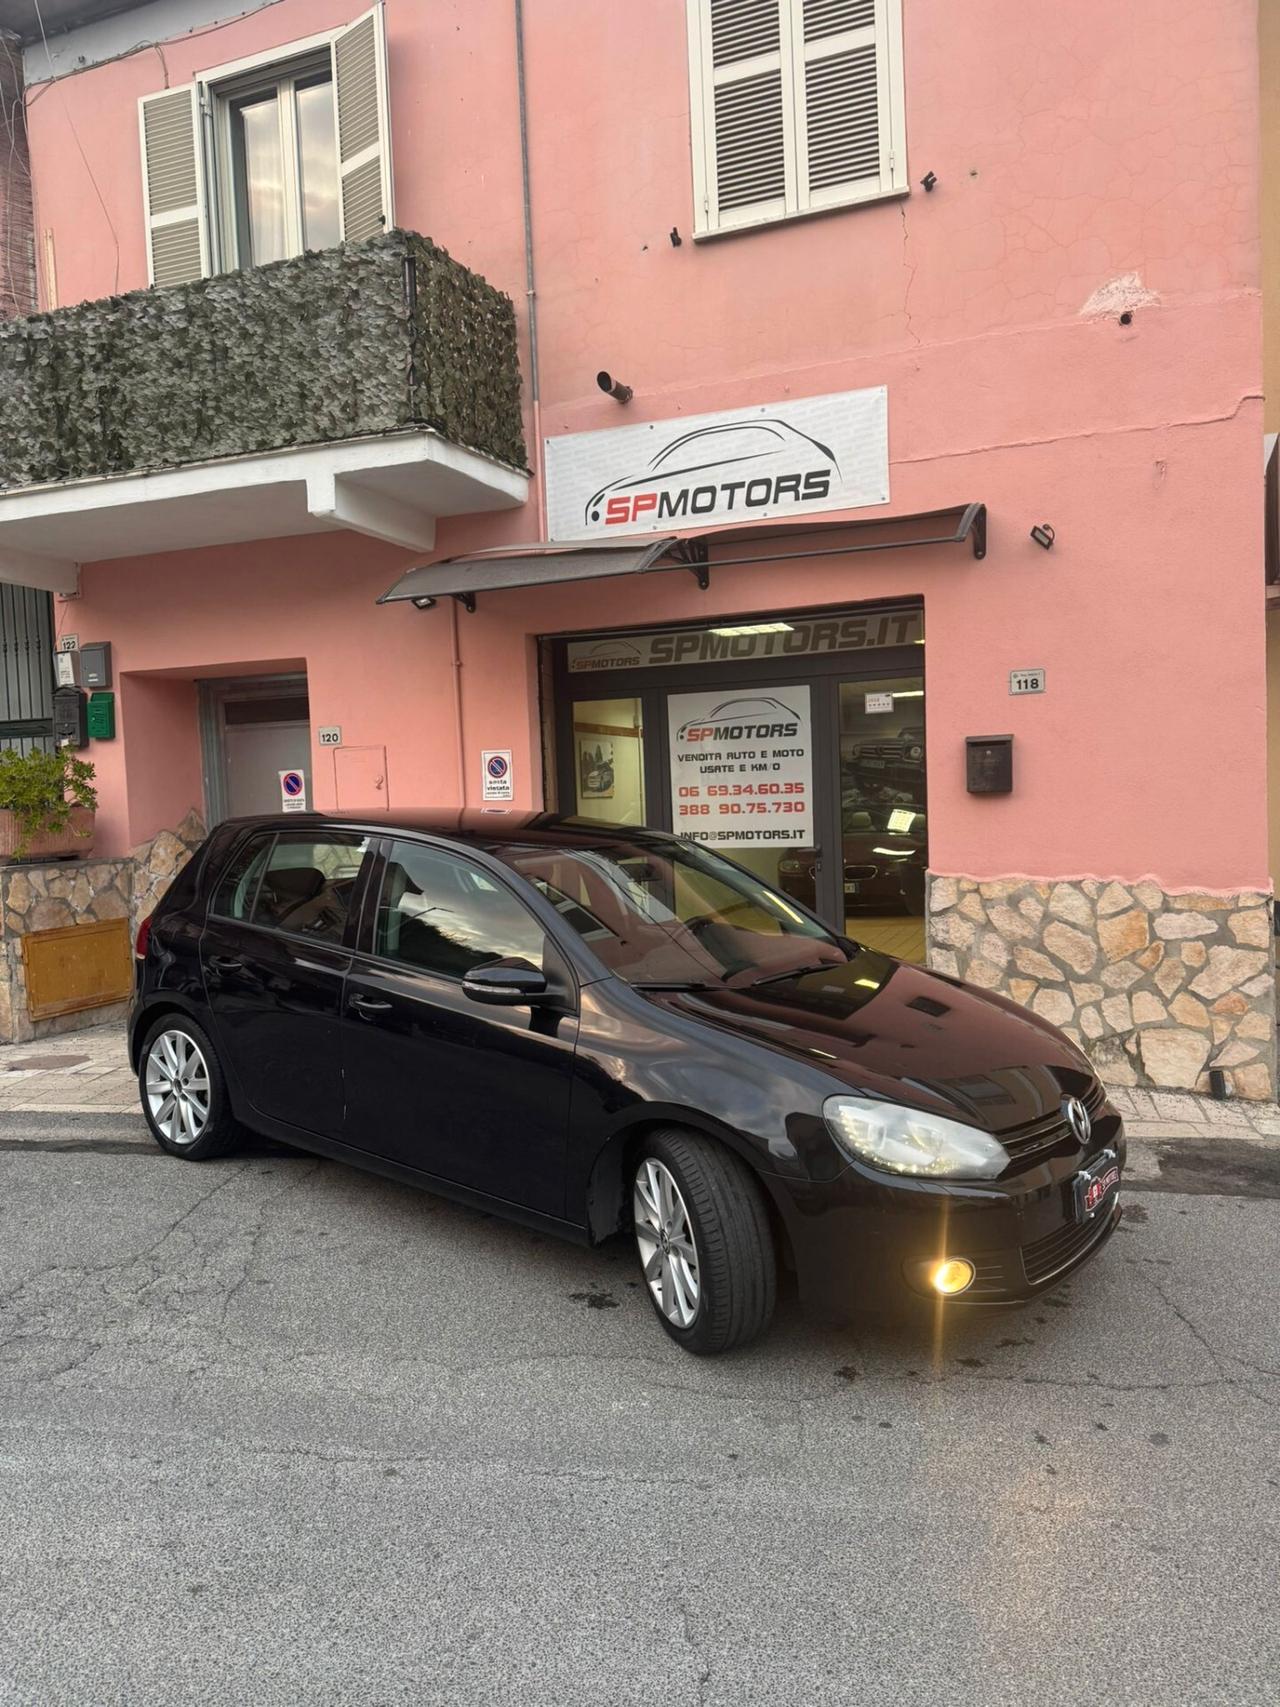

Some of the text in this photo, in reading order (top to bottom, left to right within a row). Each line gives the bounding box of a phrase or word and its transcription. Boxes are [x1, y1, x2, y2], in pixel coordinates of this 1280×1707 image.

[605, 469, 831, 525] SPMOTORS
[62, 641, 76, 650] 122
[648, 614, 918, 664] SPMOTORS.IT
[575, 656, 641, 670] SPMOTORS
[1016, 678, 1039, 690] 118
[321, 733, 339, 743] 120
[686, 722, 798, 742] SPMOTORS
[677, 748, 805, 762] VENDITA AUTO E MOTO
[699, 765, 735, 774] USATE
[739, 764, 746, 772] E
[751, 763, 768, 772] KM
[678, 782, 805, 798] 06 69.34.60.35
[679, 801, 806, 816] 388 90.75.730
[680, 829, 806, 841] INFO@SPMOTORS.IT
